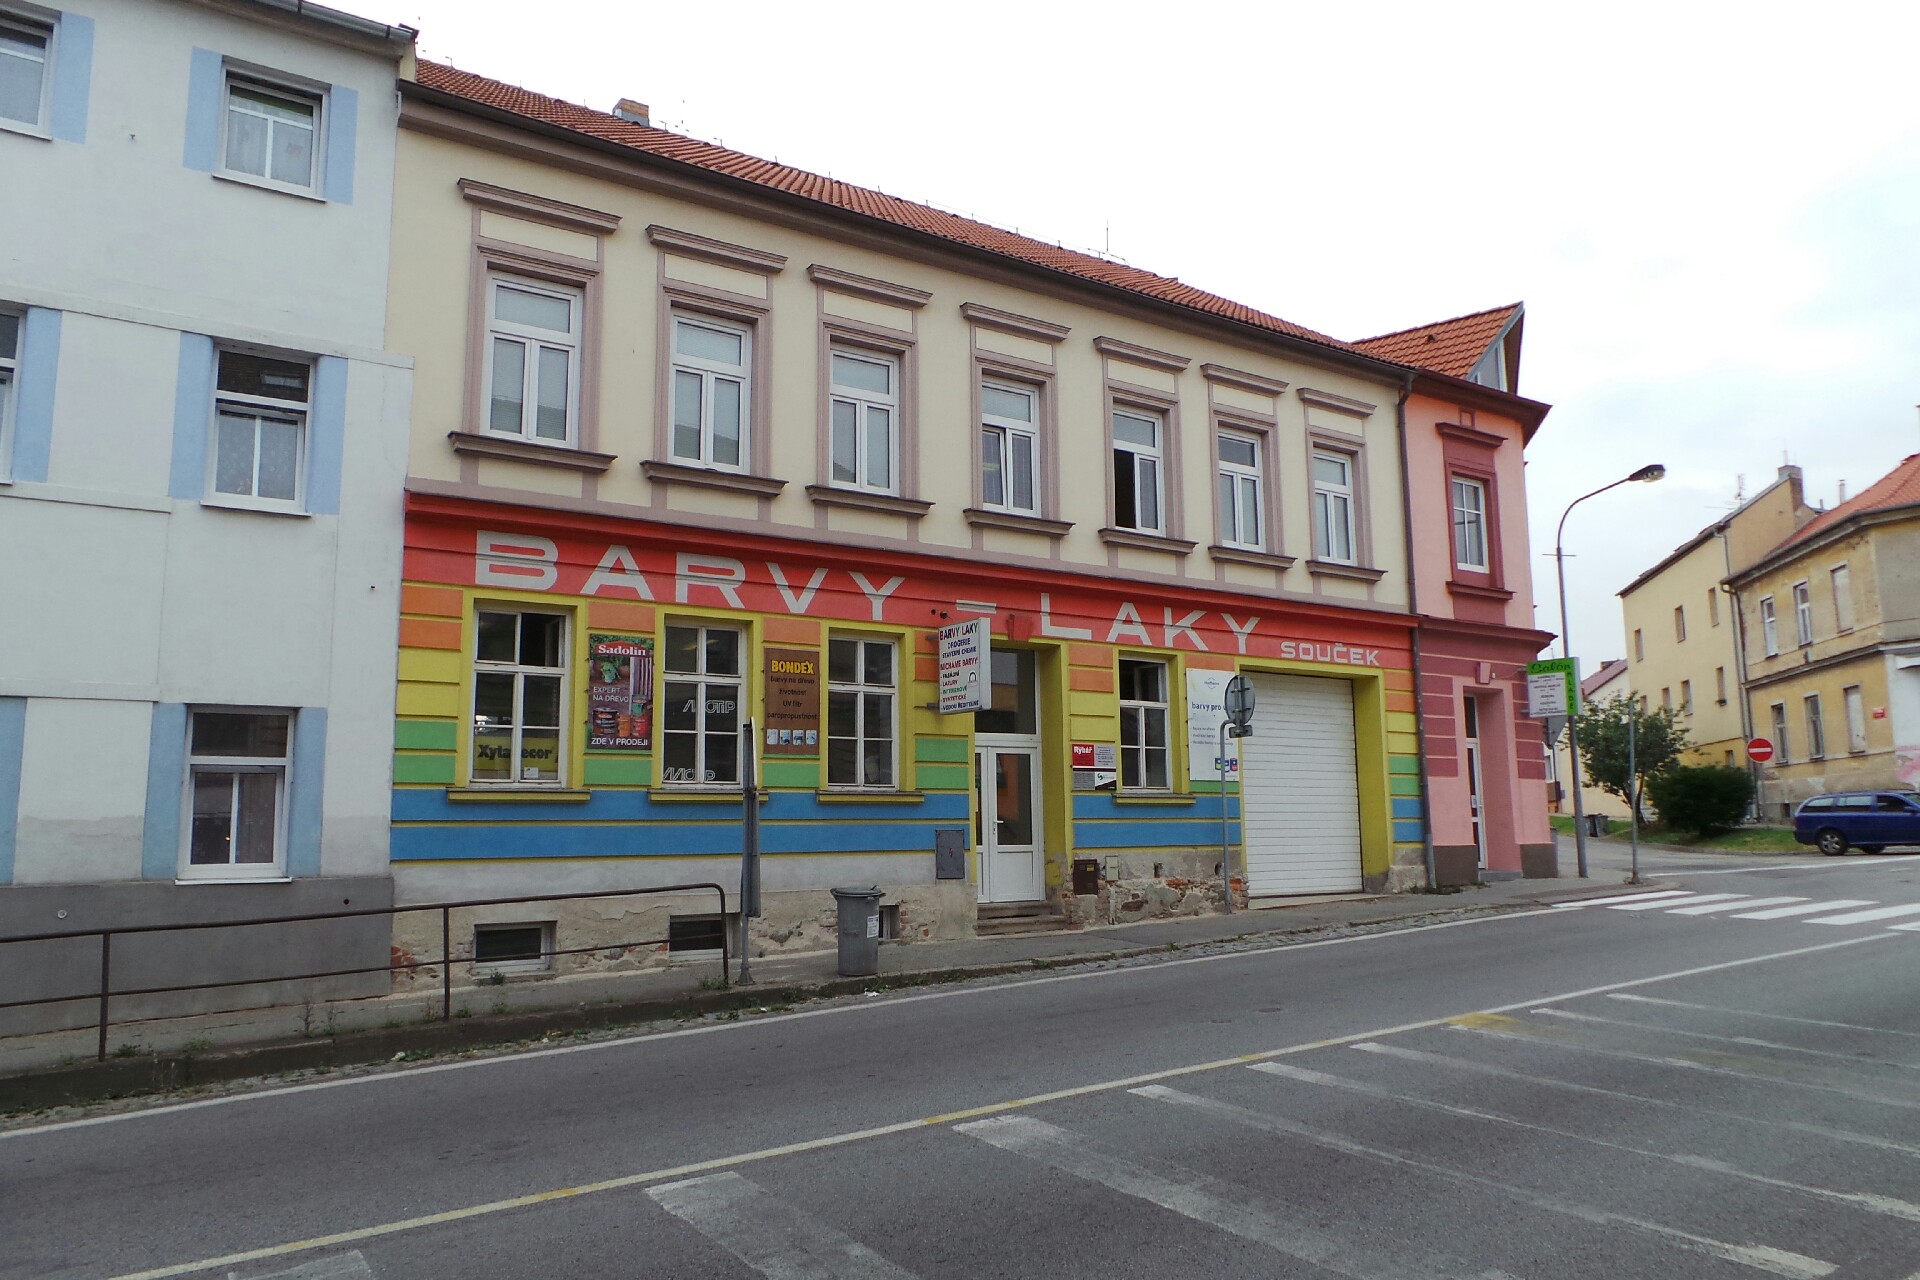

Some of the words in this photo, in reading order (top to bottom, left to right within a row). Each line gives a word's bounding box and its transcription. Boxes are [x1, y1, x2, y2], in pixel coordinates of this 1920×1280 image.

[475, 529, 905, 621] BARVY
[1040, 592, 1261, 654] LAKY
[940, 626, 960, 641] BARVY
[962, 622, 978, 636] LAKY
[947, 637, 971, 650] DROGERIE
[598, 644, 646, 656] Sadolin
[961, 645, 977, 655] CHEMIE
[1280, 640, 1381, 667] SOUČEK
[771, 660, 815, 675] BONDEX
[770, 675, 788, 684] barvy
[593, 686, 620, 694] EXPERT
[604, 695, 629, 703] DŘEVO
[1191, 702, 1210, 712] barvy
[1210, 704, 1222, 712] pro
[591, 737, 607, 745] ZDE
[616, 738, 648, 746] PRODEJI
[477, 744, 553, 760] Xylaecor
